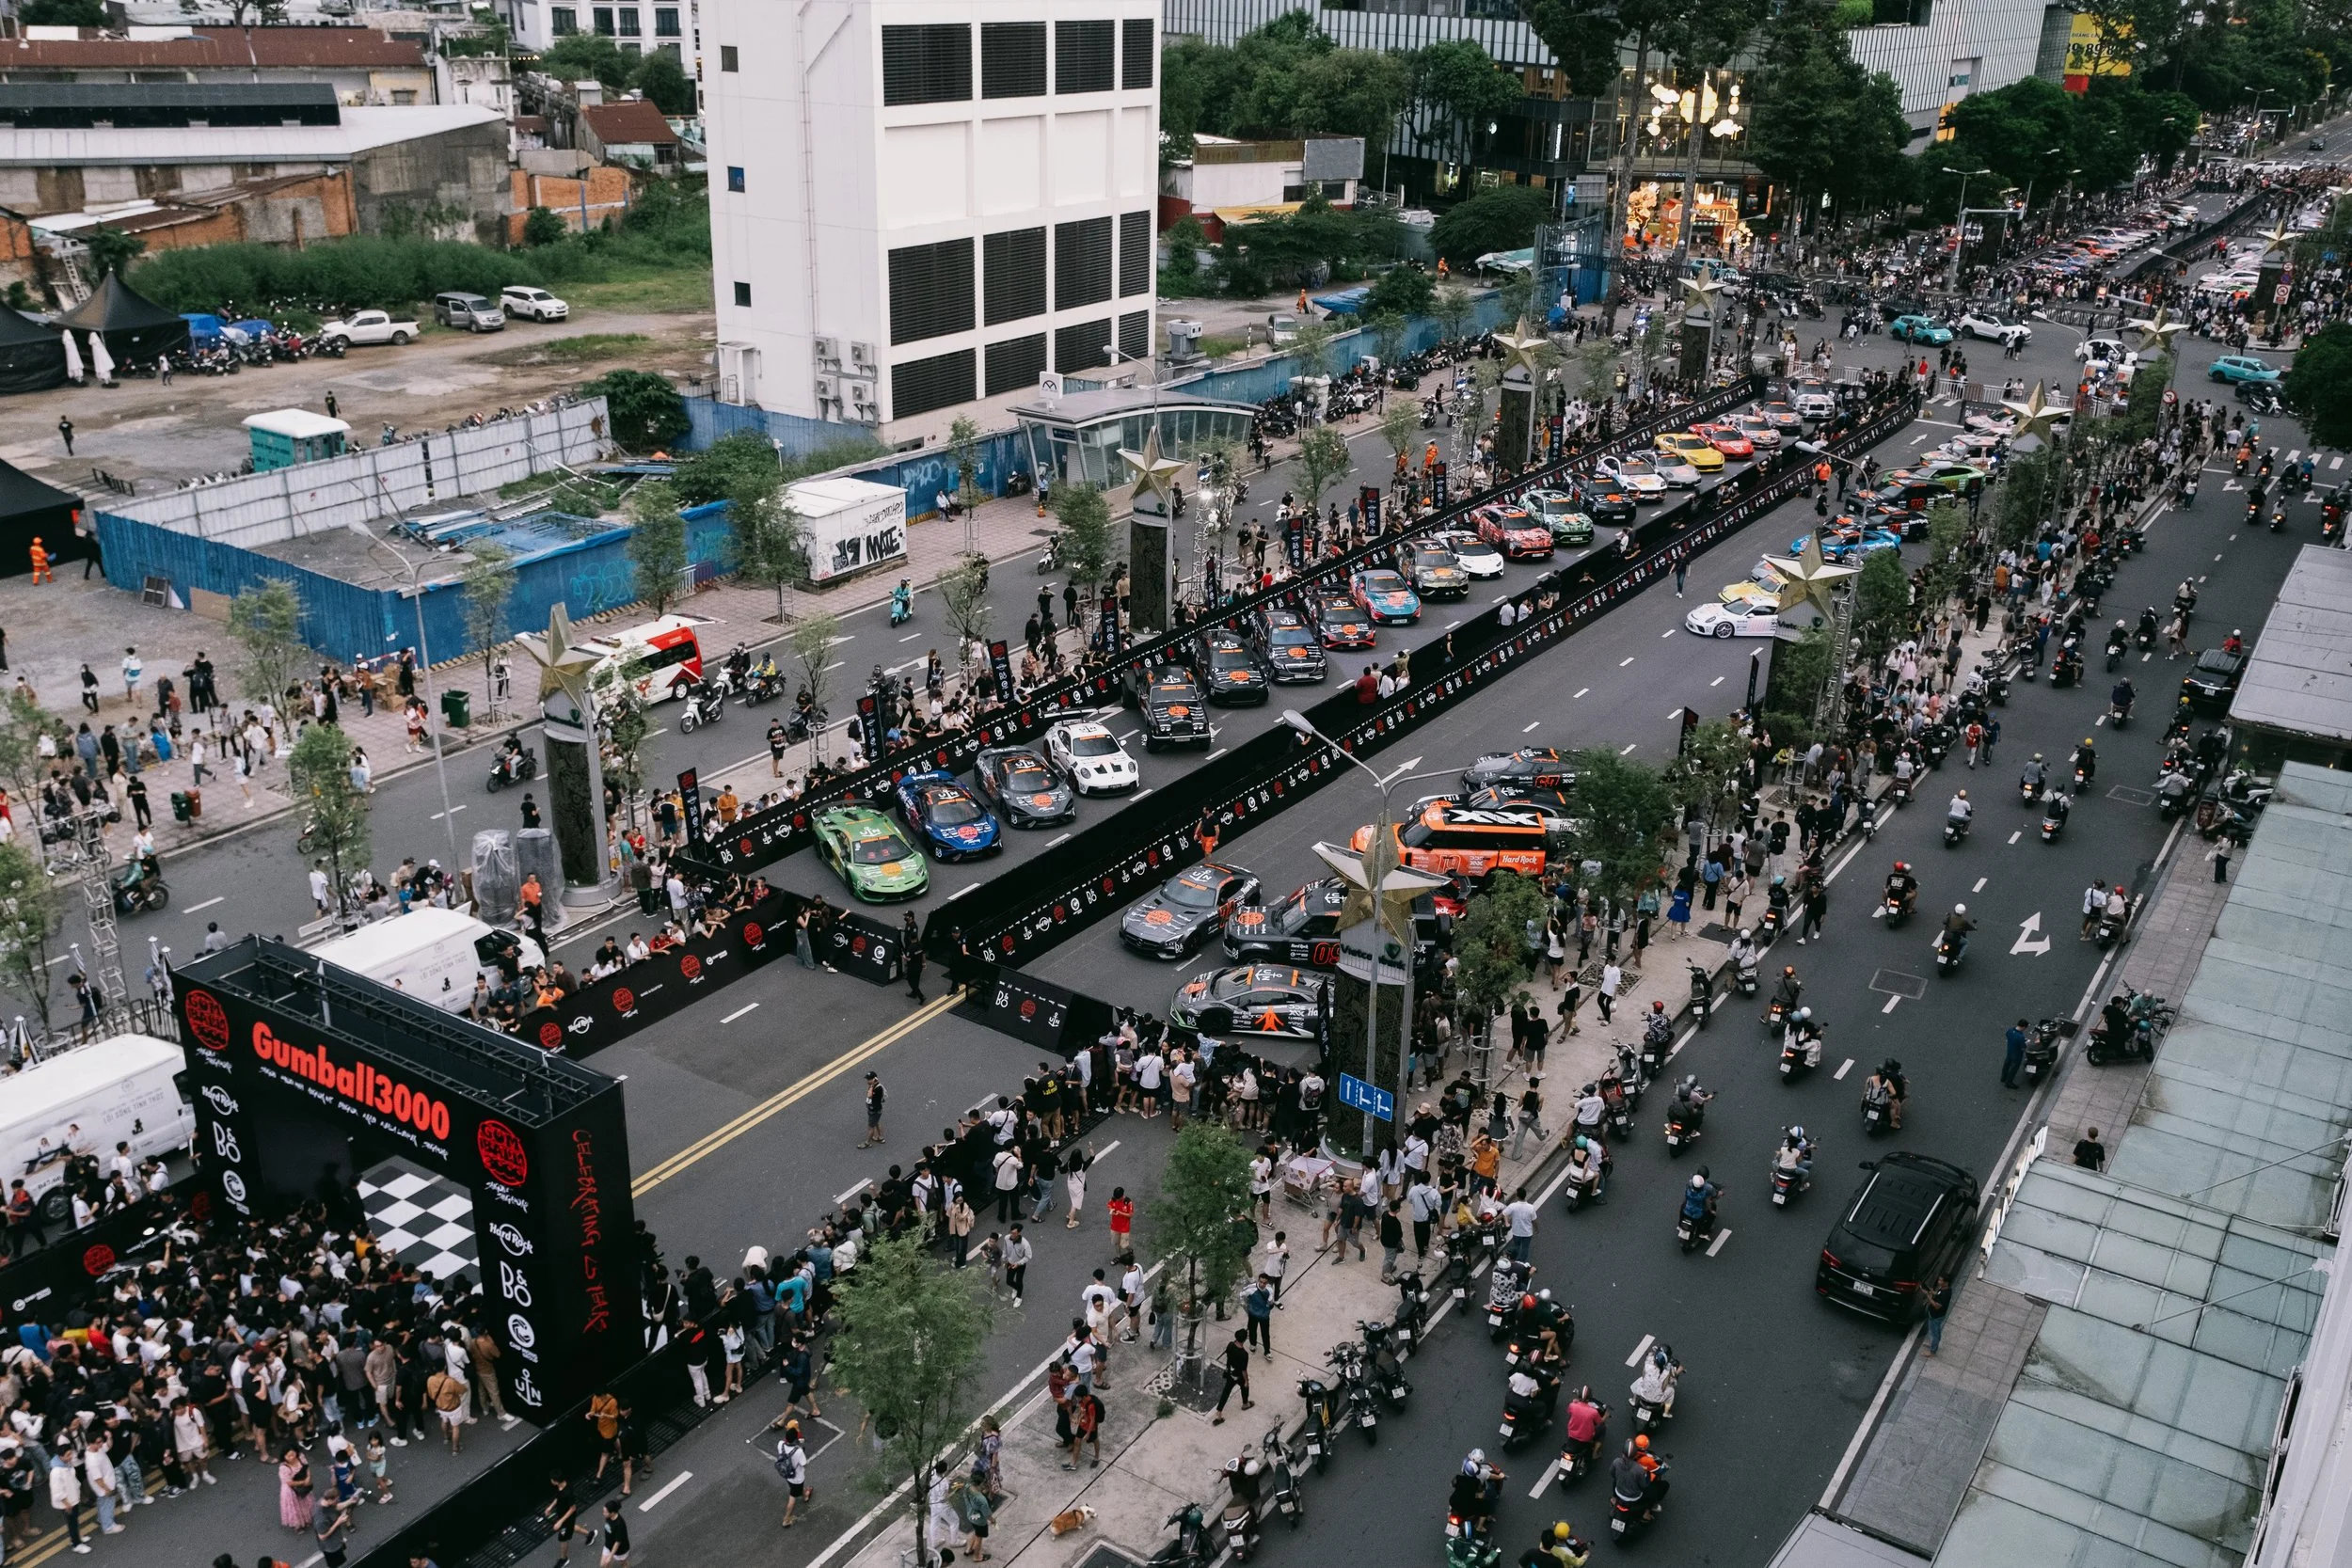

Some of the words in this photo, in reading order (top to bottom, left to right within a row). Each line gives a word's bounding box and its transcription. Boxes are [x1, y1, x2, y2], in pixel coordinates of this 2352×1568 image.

[1502, 855, 1521, 863] Hard
[1521, 855, 1538, 863] Rock
[1891, 879, 1904, 888] 86
[252, 1022, 450, 1140] Gumball3000
[201, 1085, 221, 1102] Hard
[220, 1096, 239, 1112] Rock
[570, 1129, 602, 1246] CELEBRATING
[489, 1223, 512, 1241] Hard
[511, 1232, 533, 1254] Rock
